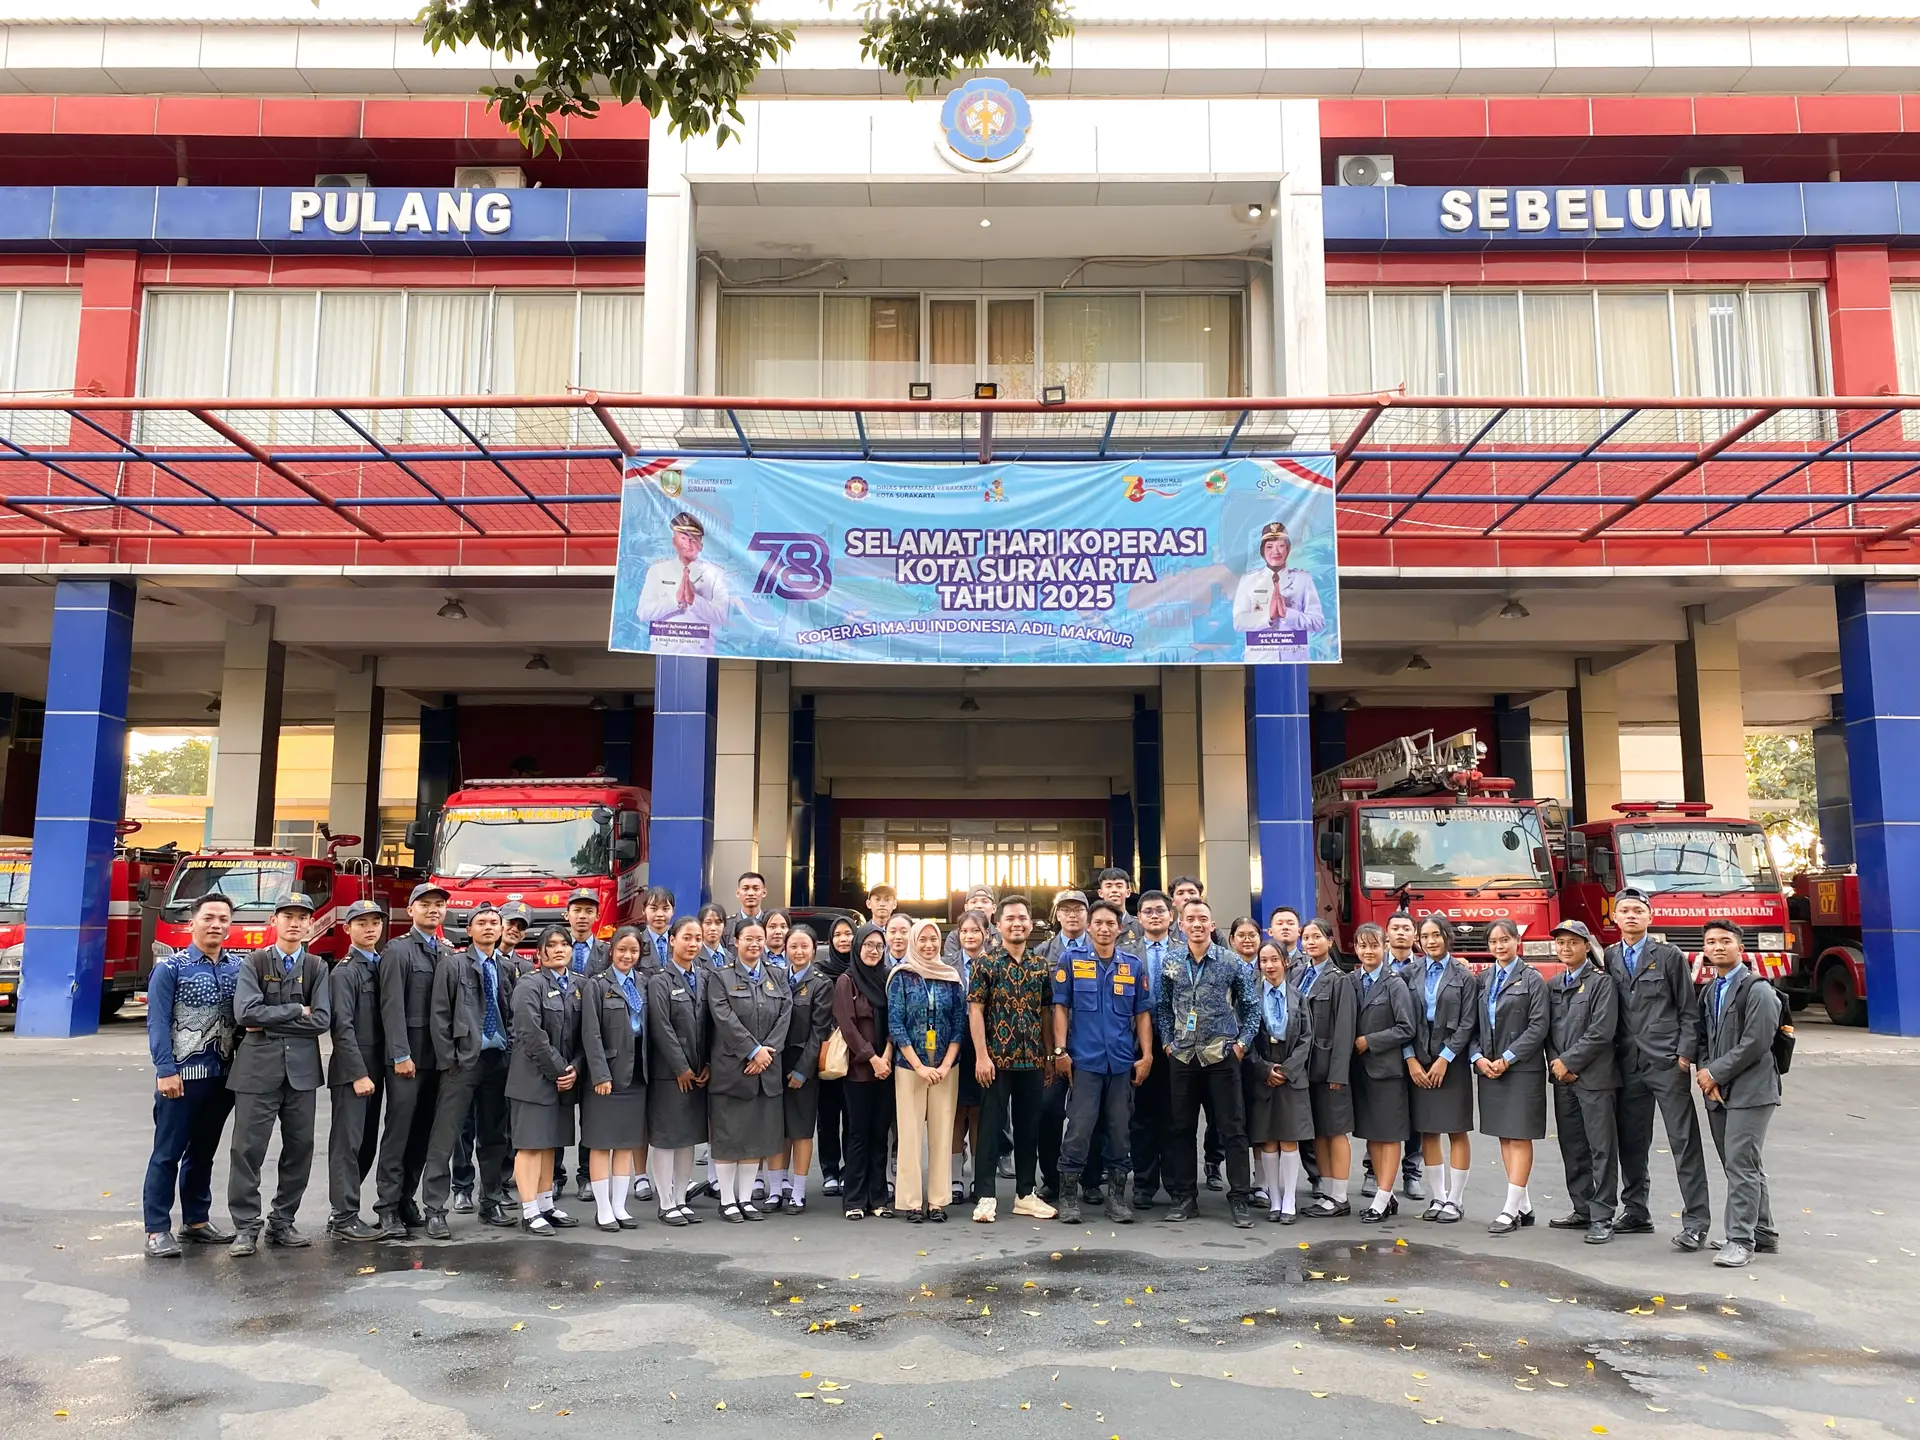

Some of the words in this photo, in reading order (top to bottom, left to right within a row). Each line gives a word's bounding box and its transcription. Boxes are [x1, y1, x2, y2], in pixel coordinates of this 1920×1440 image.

[289, 190, 513, 235] PULANG
[1439, 187, 1714, 232] SEBELUM
[845, 530, 982, 557] SELAMAT
[987, 530, 1055, 557] HARI
[1063, 529, 1205, 556] KOPERASI
[746, 531, 833, 601] 78
[898, 557, 974, 583] KOTA
[980, 556, 1155, 583] SURAKARTA
[938, 584, 1036, 610] TAHUN
[1042, 584, 1115, 609] 2025
[797, 622, 877, 645] KOPERASI
[880, 619, 926, 635] MAJU
[930, 619, 1017, 634] INDONESIA
[1020, 622, 1057, 637] ADIL
[1060, 625, 1134, 648] MAKMUR
[536, 809, 593, 820] KEBAKAR
[1389, 809, 1447, 823] PEMADAM
[1449, 809, 1520, 823] KEBAKARAN
[1643, 832, 1689, 845] PEMADAM
[186, 861, 207, 869] DINAS
[208, 860, 242, 869] PEMADAM
[243, 860, 288, 869] KEBAKARAN
[543, 894, 560, 905] 18
[1416, 908, 1510, 917] DAEWOO
[1708, 907, 1774, 917] KEBAKARAN
[243, 932, 264, 945] 15
